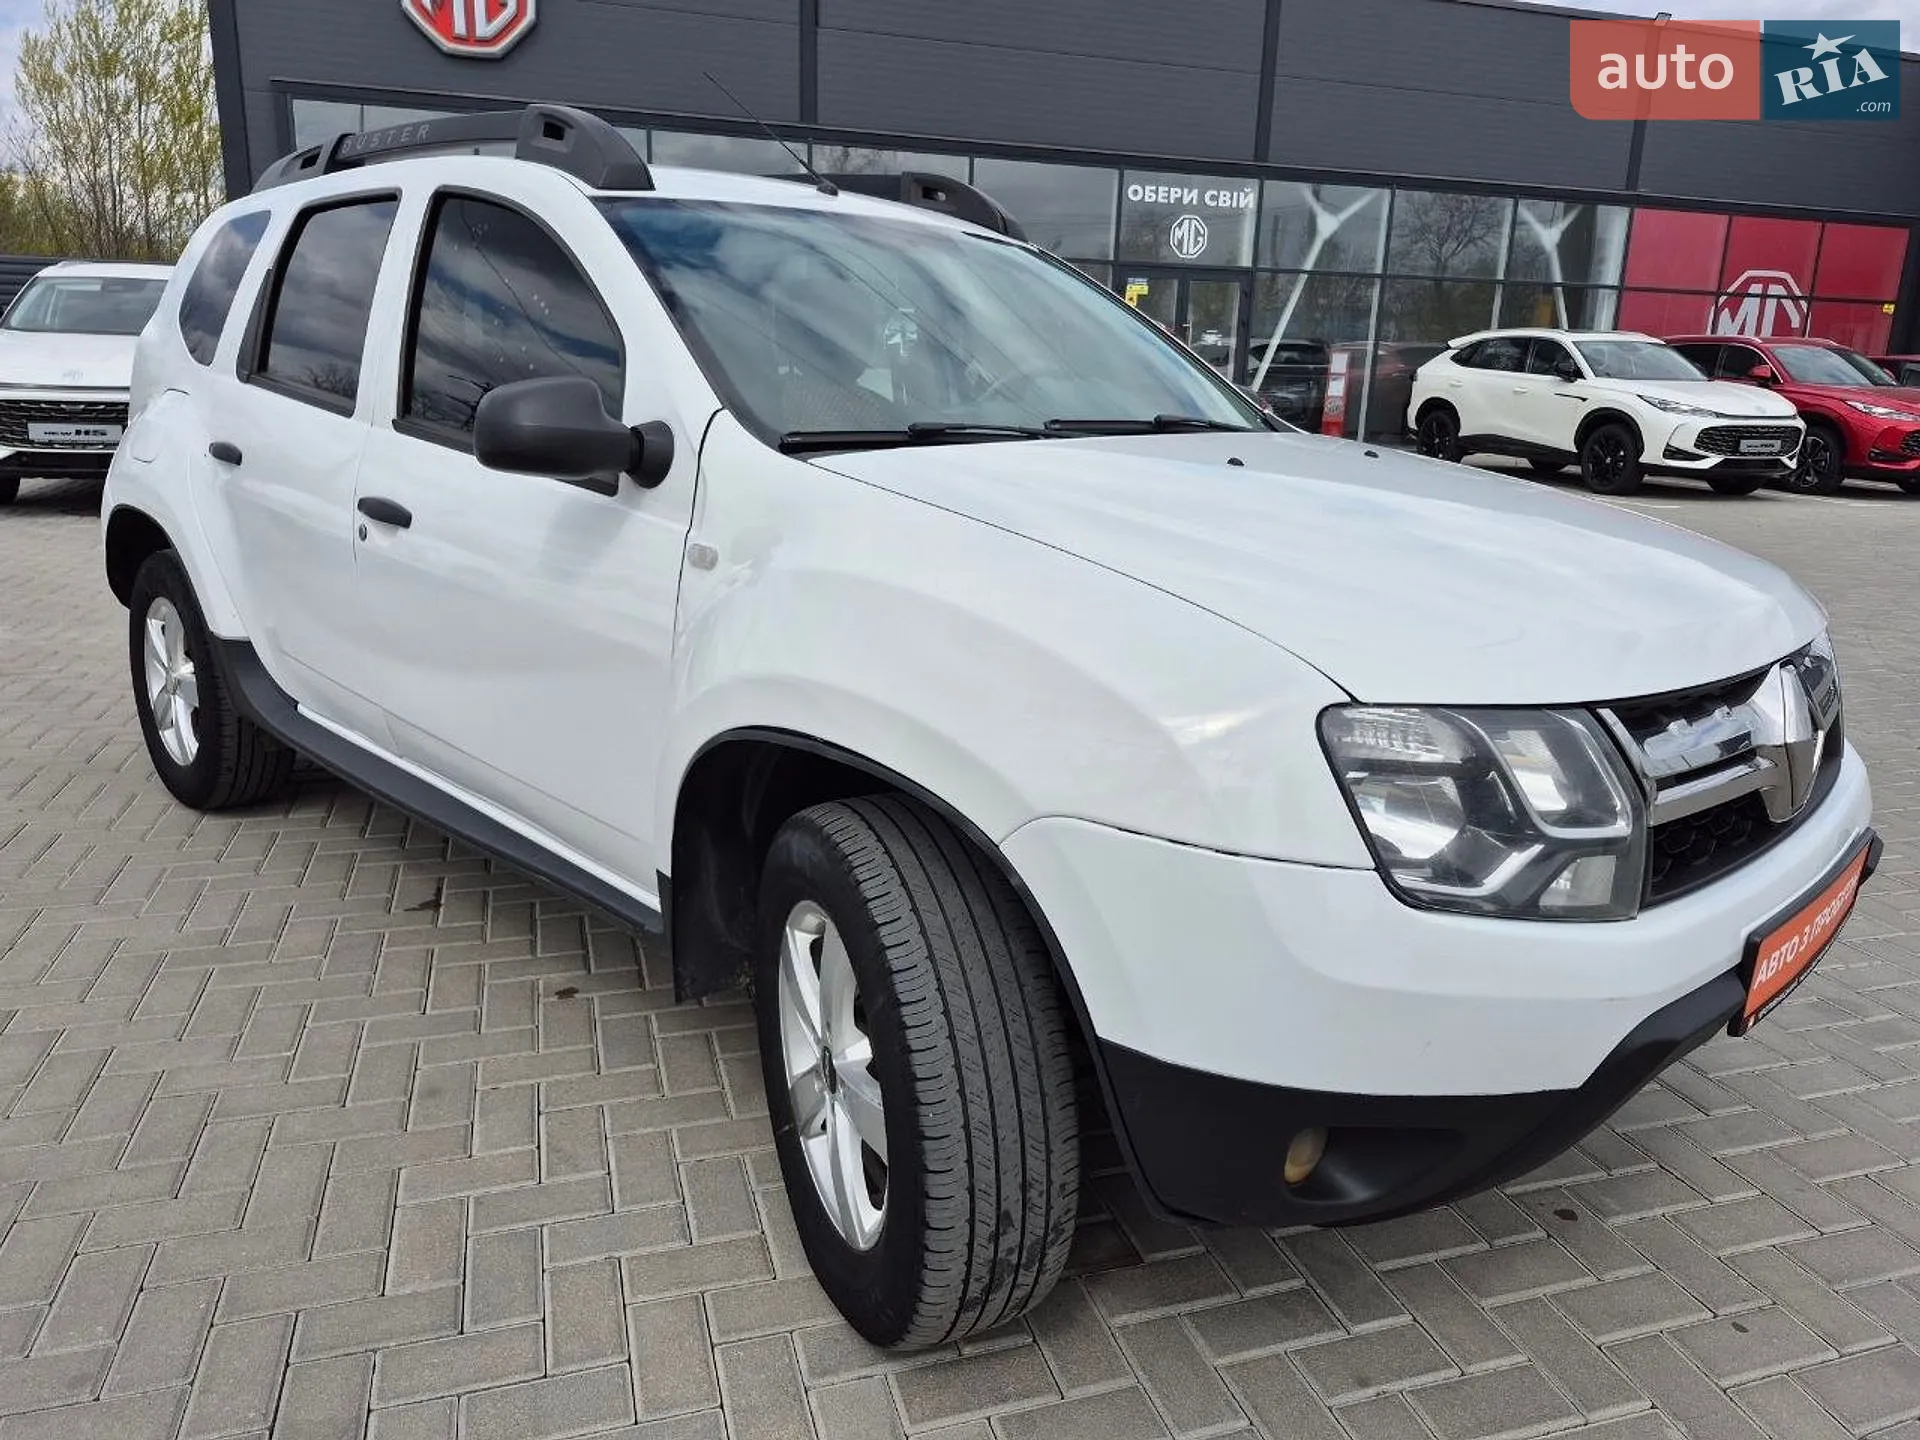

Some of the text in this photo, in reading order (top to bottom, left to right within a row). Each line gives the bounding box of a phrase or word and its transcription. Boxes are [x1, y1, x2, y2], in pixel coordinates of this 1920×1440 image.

[341, 123, 431, 154] DUSTER
[1127, 184, 1256, 208] ОБЕРИ СВІЙ
[1174, 218, 1205, 255] MG
[1753, 934, 1800, 990] АВТО
